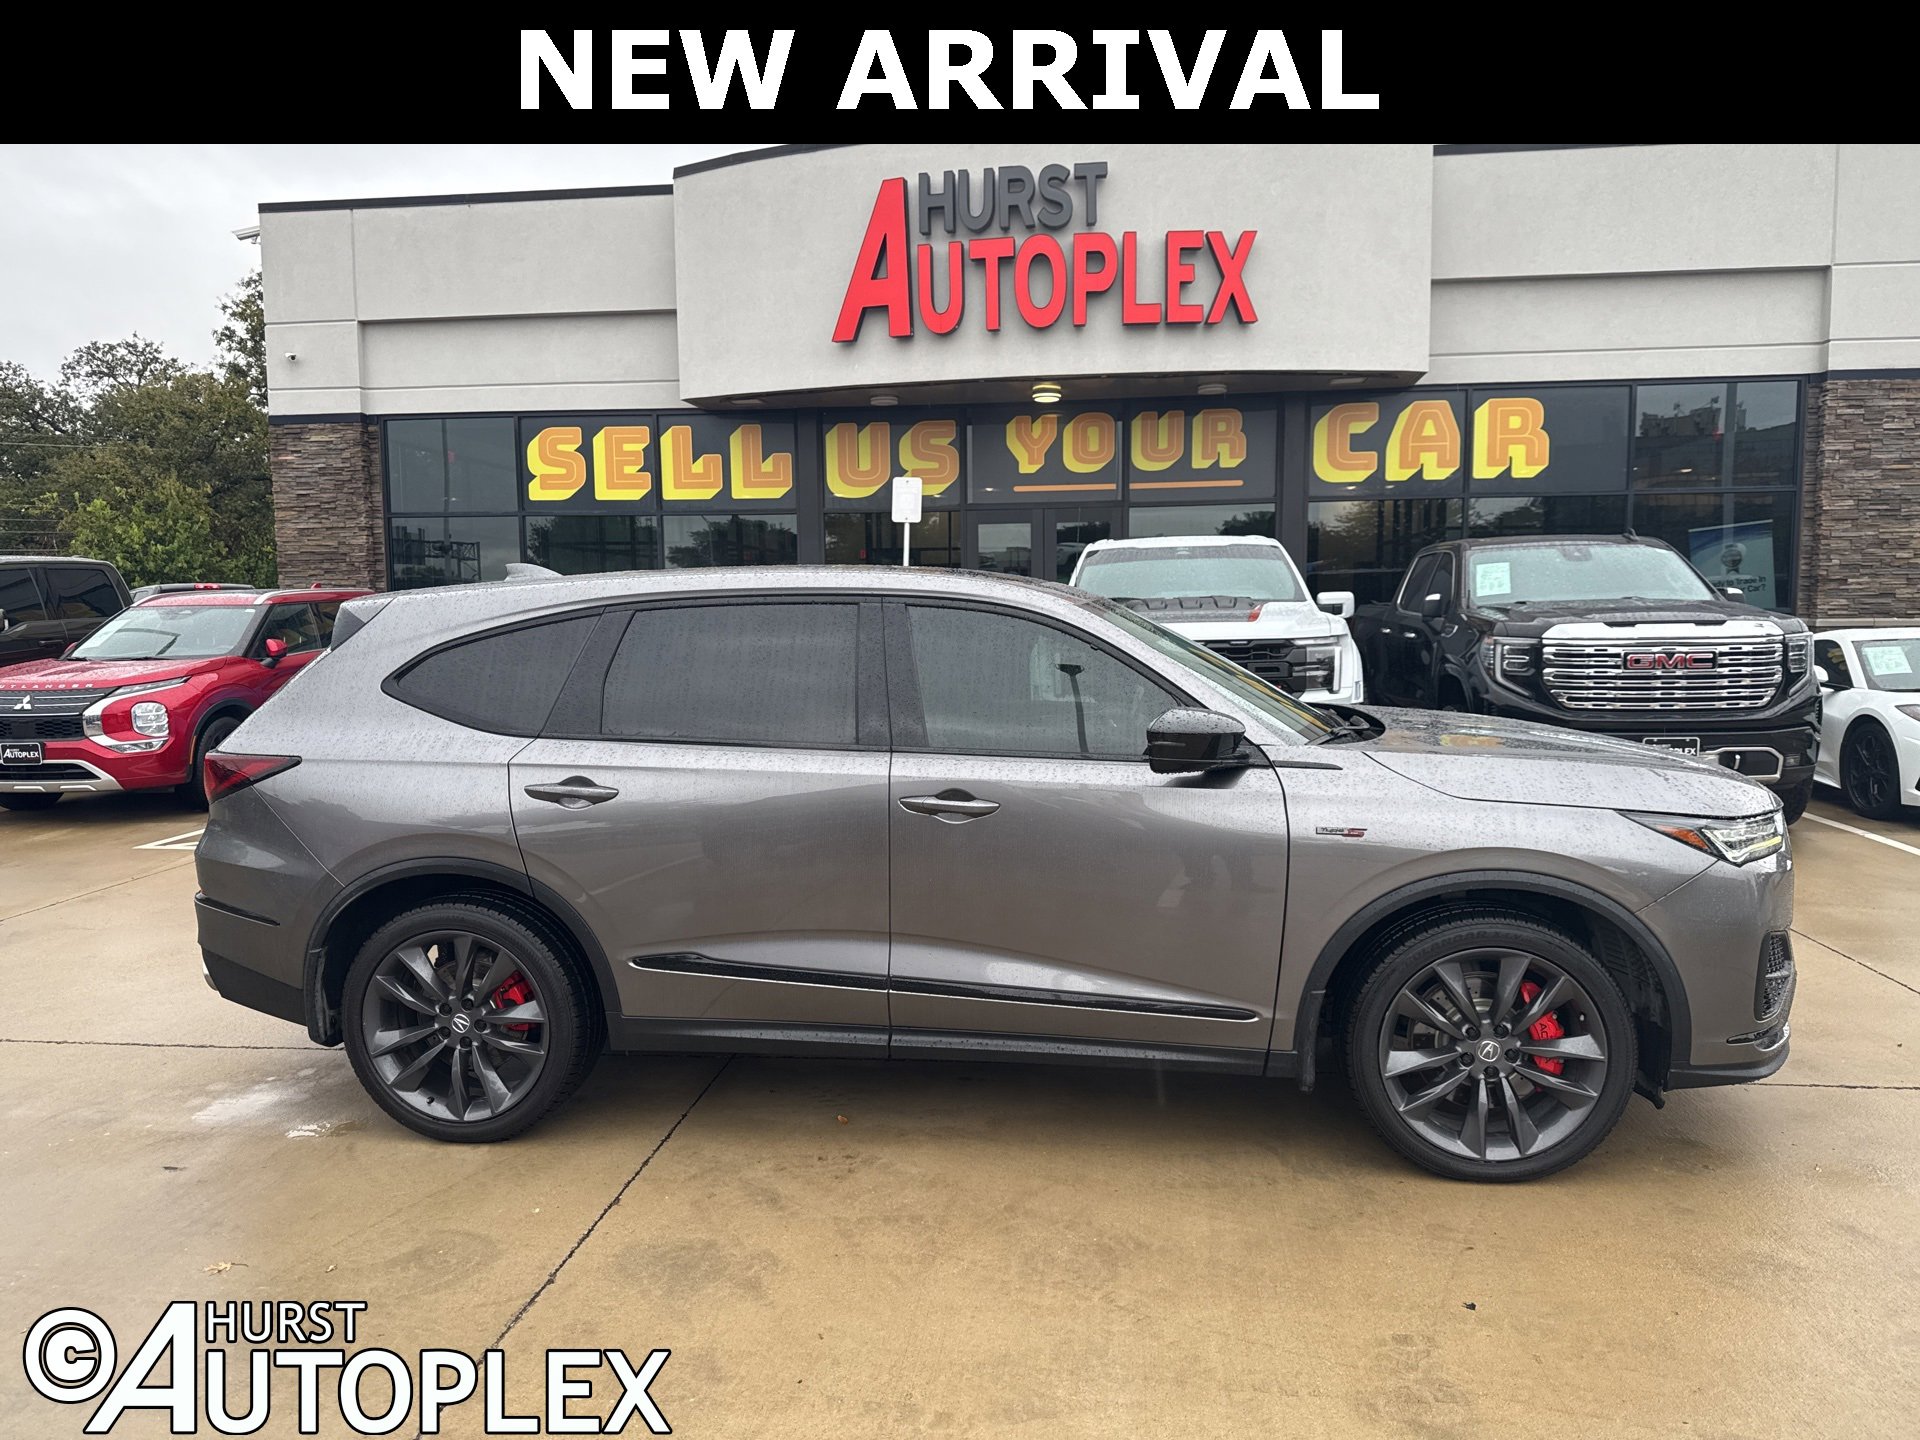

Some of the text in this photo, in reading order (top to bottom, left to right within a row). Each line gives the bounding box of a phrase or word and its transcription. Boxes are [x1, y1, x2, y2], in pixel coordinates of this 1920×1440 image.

[917, 161, 1108, 236] HURST
[831, 176, 1258, 343] AUTOPLEX
[526, 397, 1551, 502] SELL US YOUR CAR
[1627, 653, 1714, 669] GMC
[3, 748, 40, 759] AUTOPLEX
